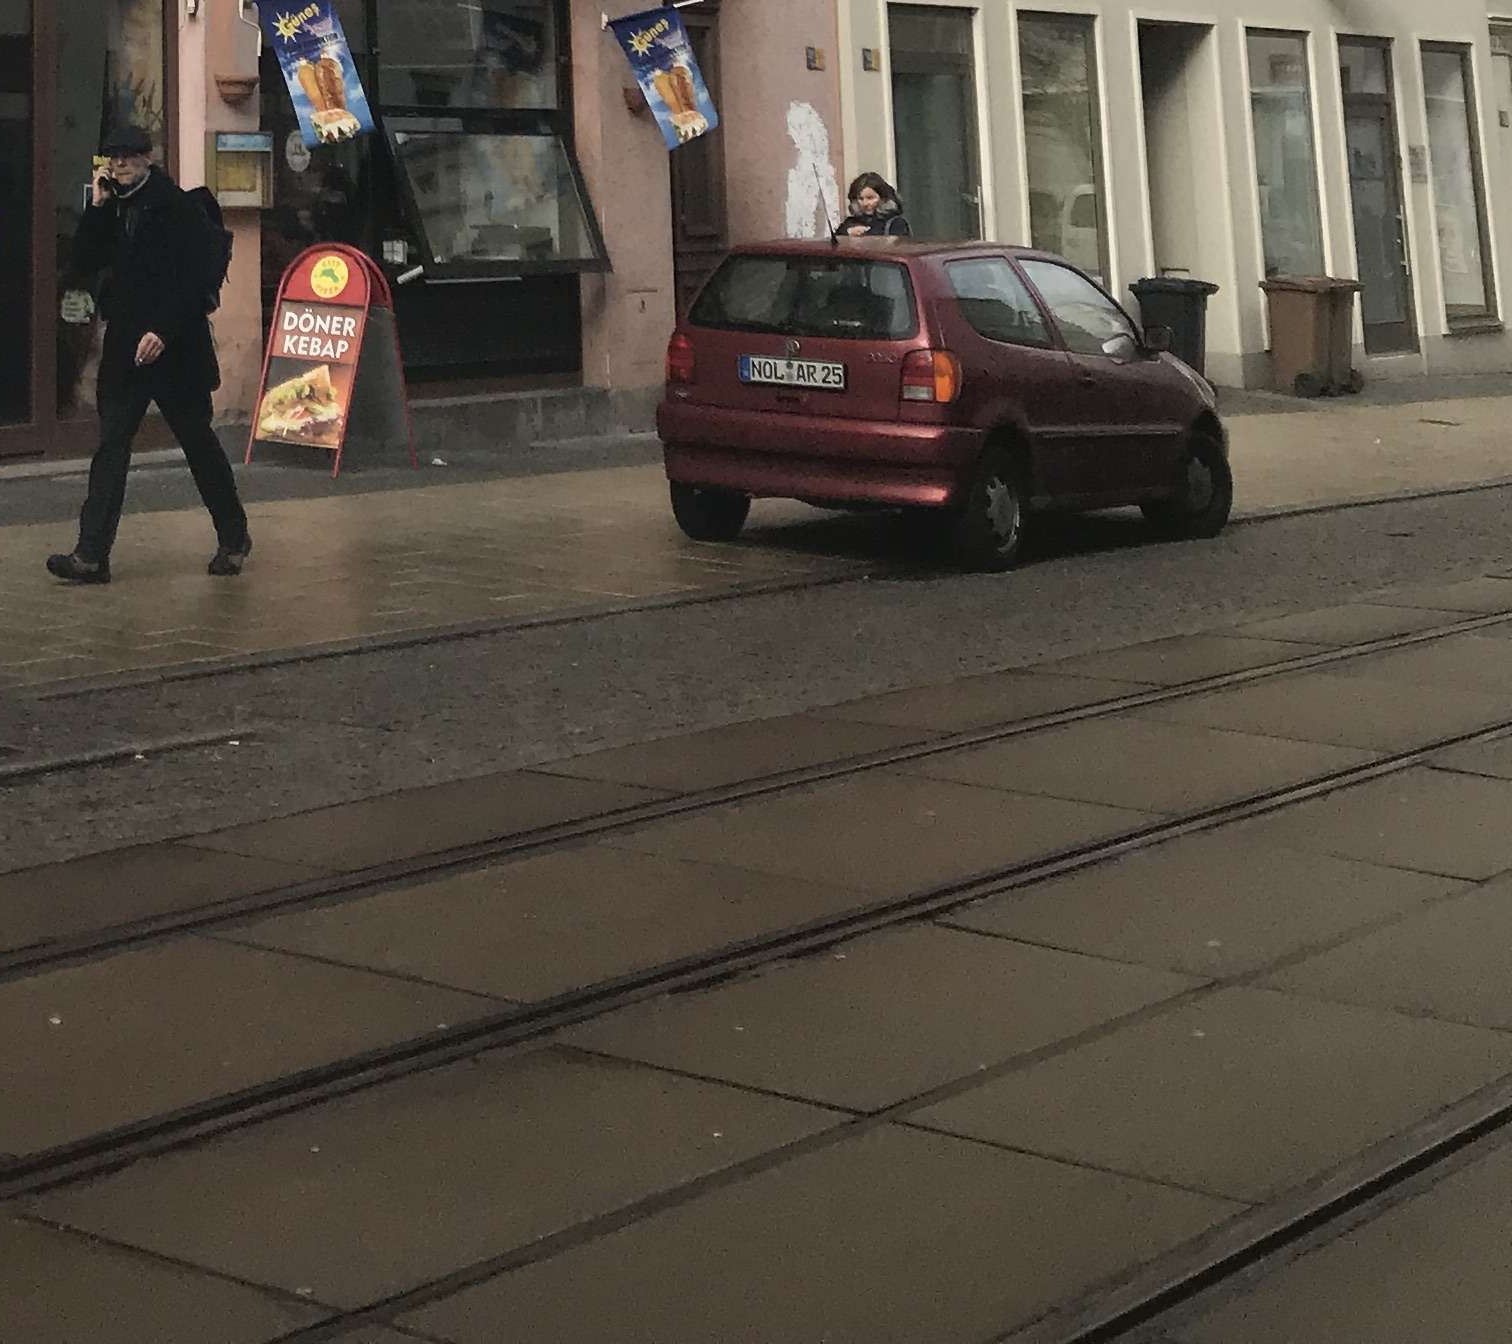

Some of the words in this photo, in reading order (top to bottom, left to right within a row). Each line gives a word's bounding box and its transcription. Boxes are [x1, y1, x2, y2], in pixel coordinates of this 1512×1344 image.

[283, 308, 356, 337] DÖNER
[282, 334, 349, 359] KEBAP
[751, 361, 785, 381] NOL
[796, 364, 818, 383] AR
[821, 365, 843, 385] 25
